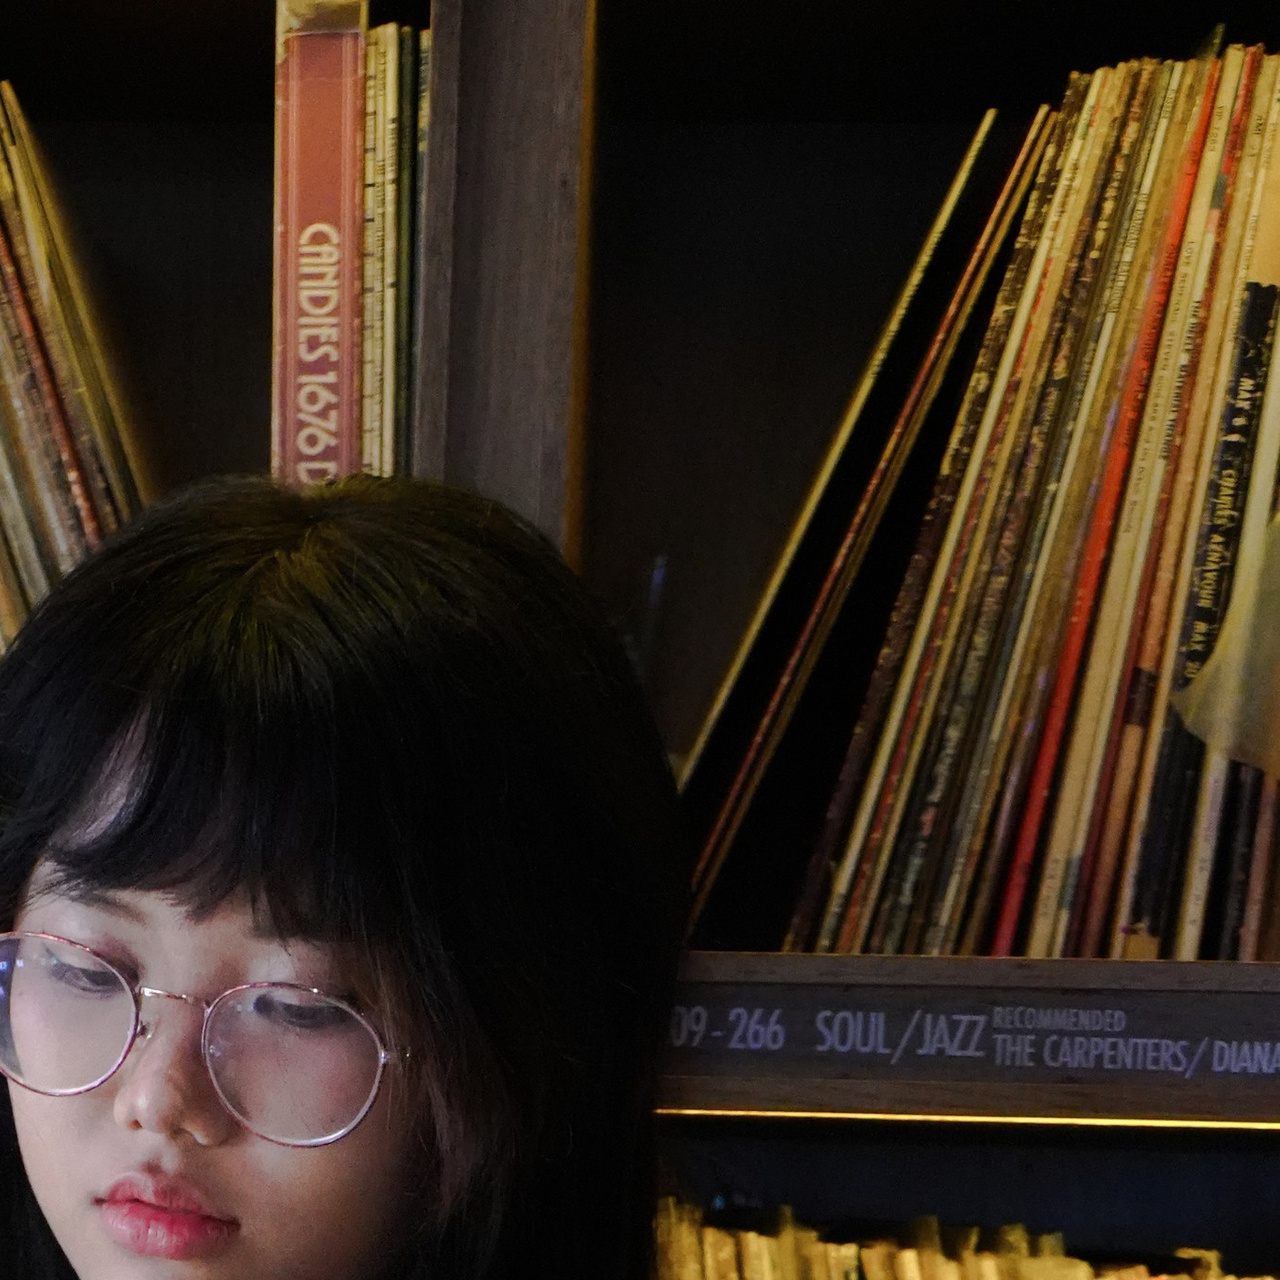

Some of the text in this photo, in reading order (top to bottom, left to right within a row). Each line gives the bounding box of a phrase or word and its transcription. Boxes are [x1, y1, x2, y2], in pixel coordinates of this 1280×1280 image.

[296, 223, 340, 362] CANDIES
[295, 371, 339, 455] 1676
[728, 1007, 785, 1050] 266
[816, 1010, 988, 1065] SOUL/JAZZ
[993, 1006, 1126, 1032] RECOMMENDED
[994, 1034, 1036, 1067] THE
